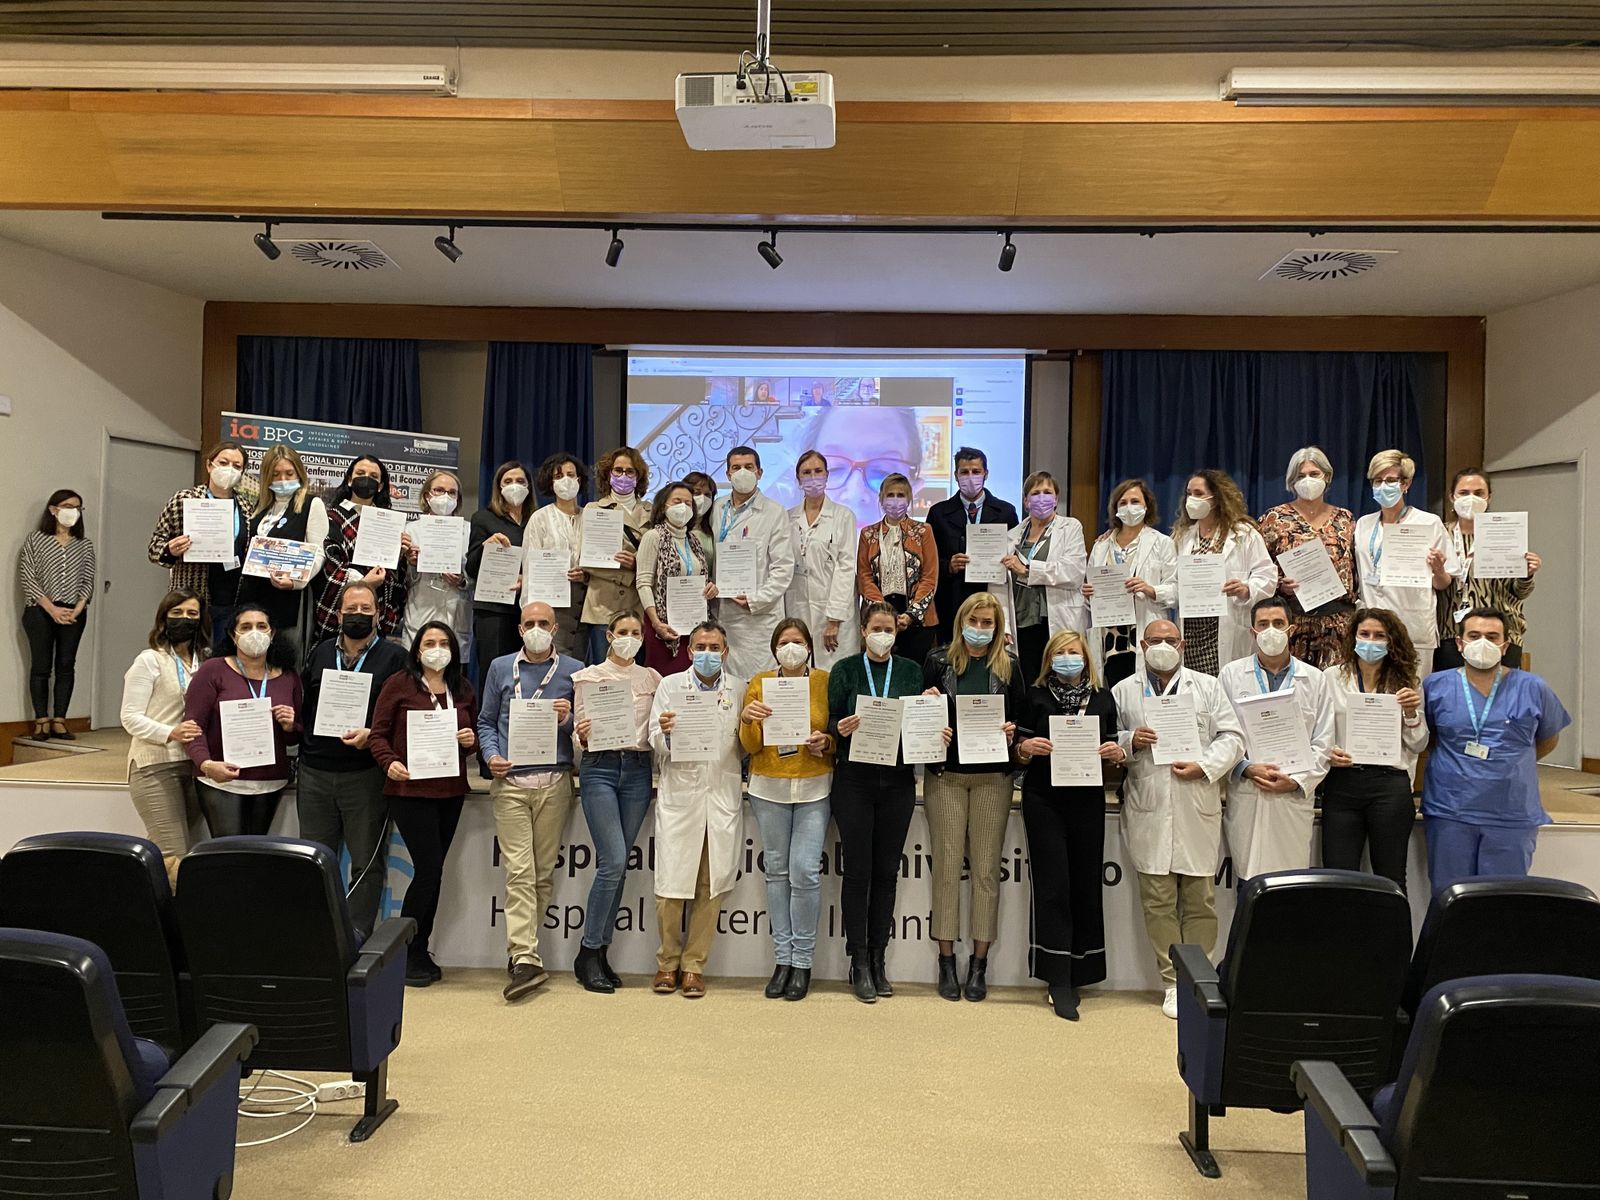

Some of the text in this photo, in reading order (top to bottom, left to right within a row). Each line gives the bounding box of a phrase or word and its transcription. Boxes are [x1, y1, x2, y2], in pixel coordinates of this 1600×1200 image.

[263, 426, 304, 443] BPG
[308, 431, 350, 439] INTERNATIONAL
[300, 455, 330, 466] GIONAL
[395, 464, 406, 472] DE
[407, 465, 438, 475] MÁLAG
